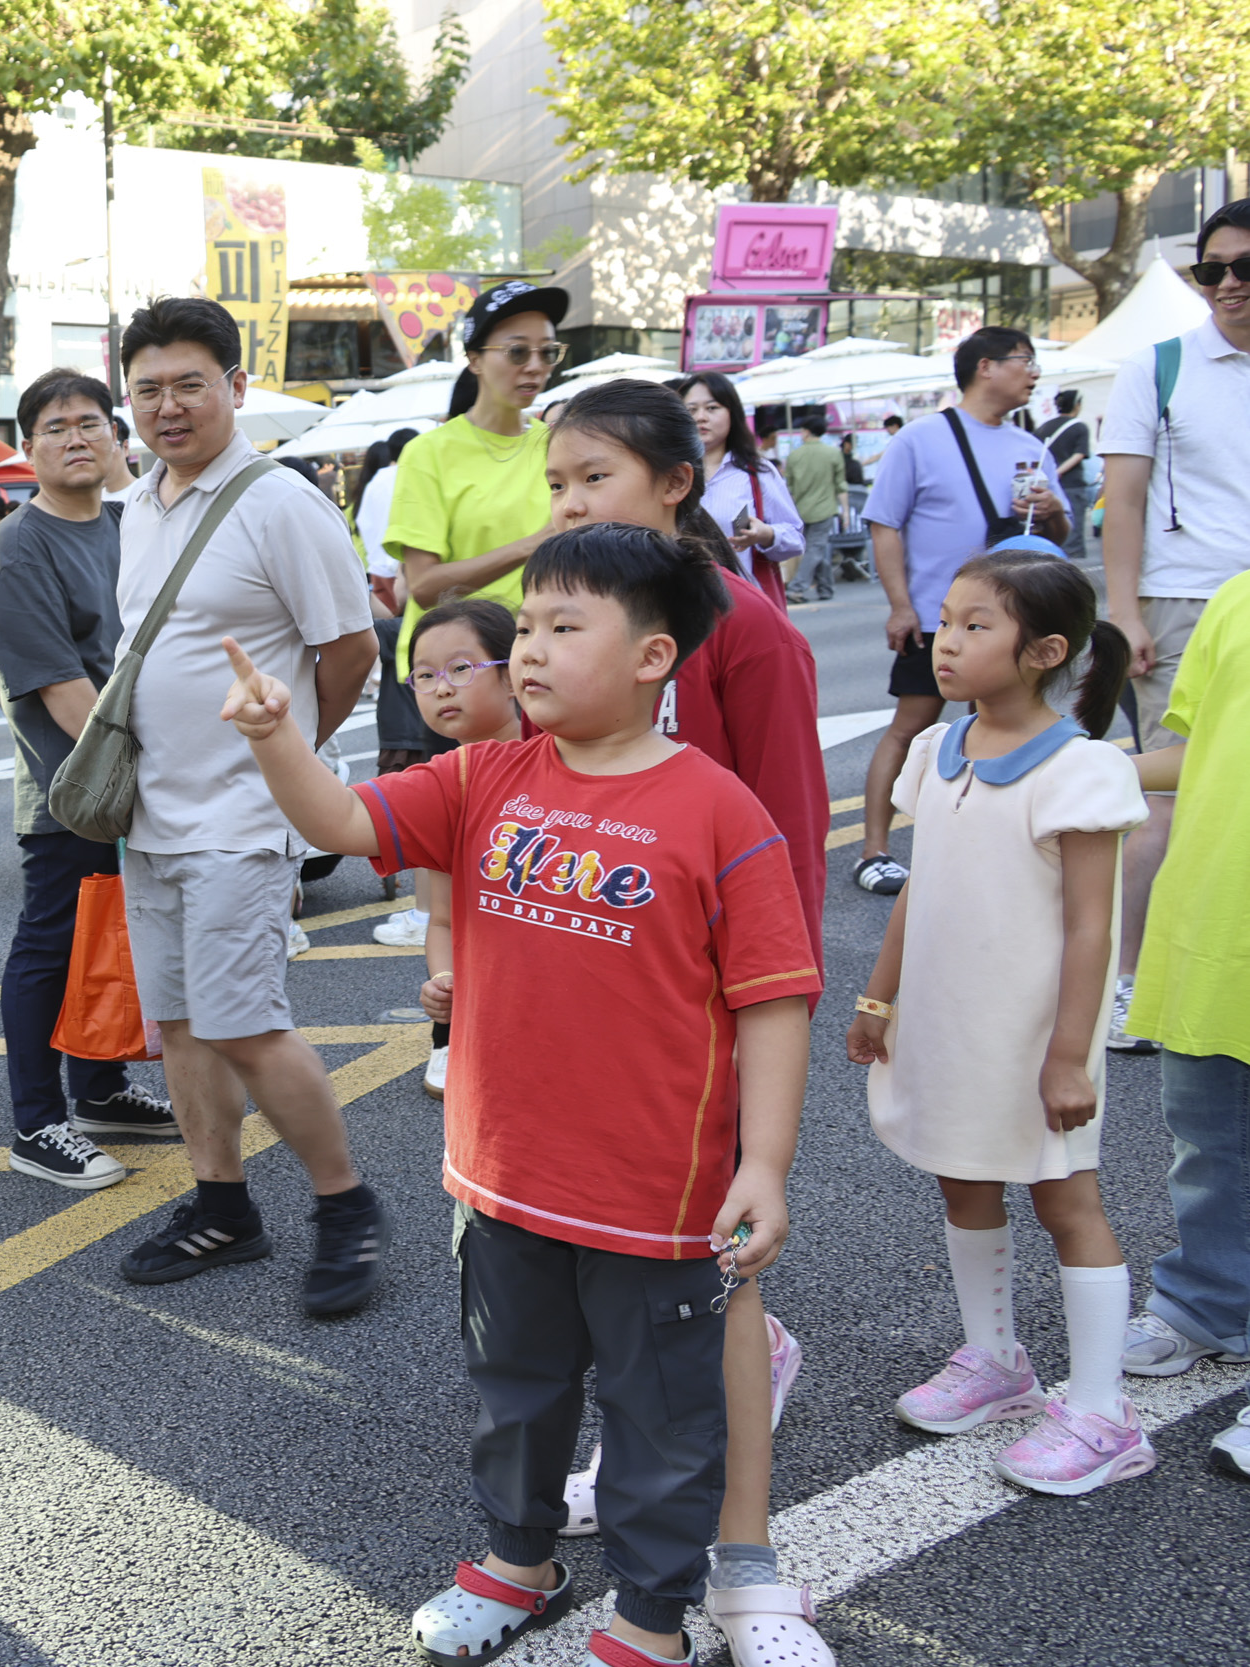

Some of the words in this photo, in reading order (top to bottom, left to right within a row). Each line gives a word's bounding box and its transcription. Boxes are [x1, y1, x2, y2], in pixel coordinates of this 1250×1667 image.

[262, 240, 284, 383] PIZZA
[499, 794, 545, 820] See
[541, 809, 592, 829] you
[596, 818, 657, 844] soon
[479, 821, 655, 909] Here
[479, 895, 500, 910] NO
[513, 903, 555, 923] BAD
[570, 916, 632, 941] DAYS
